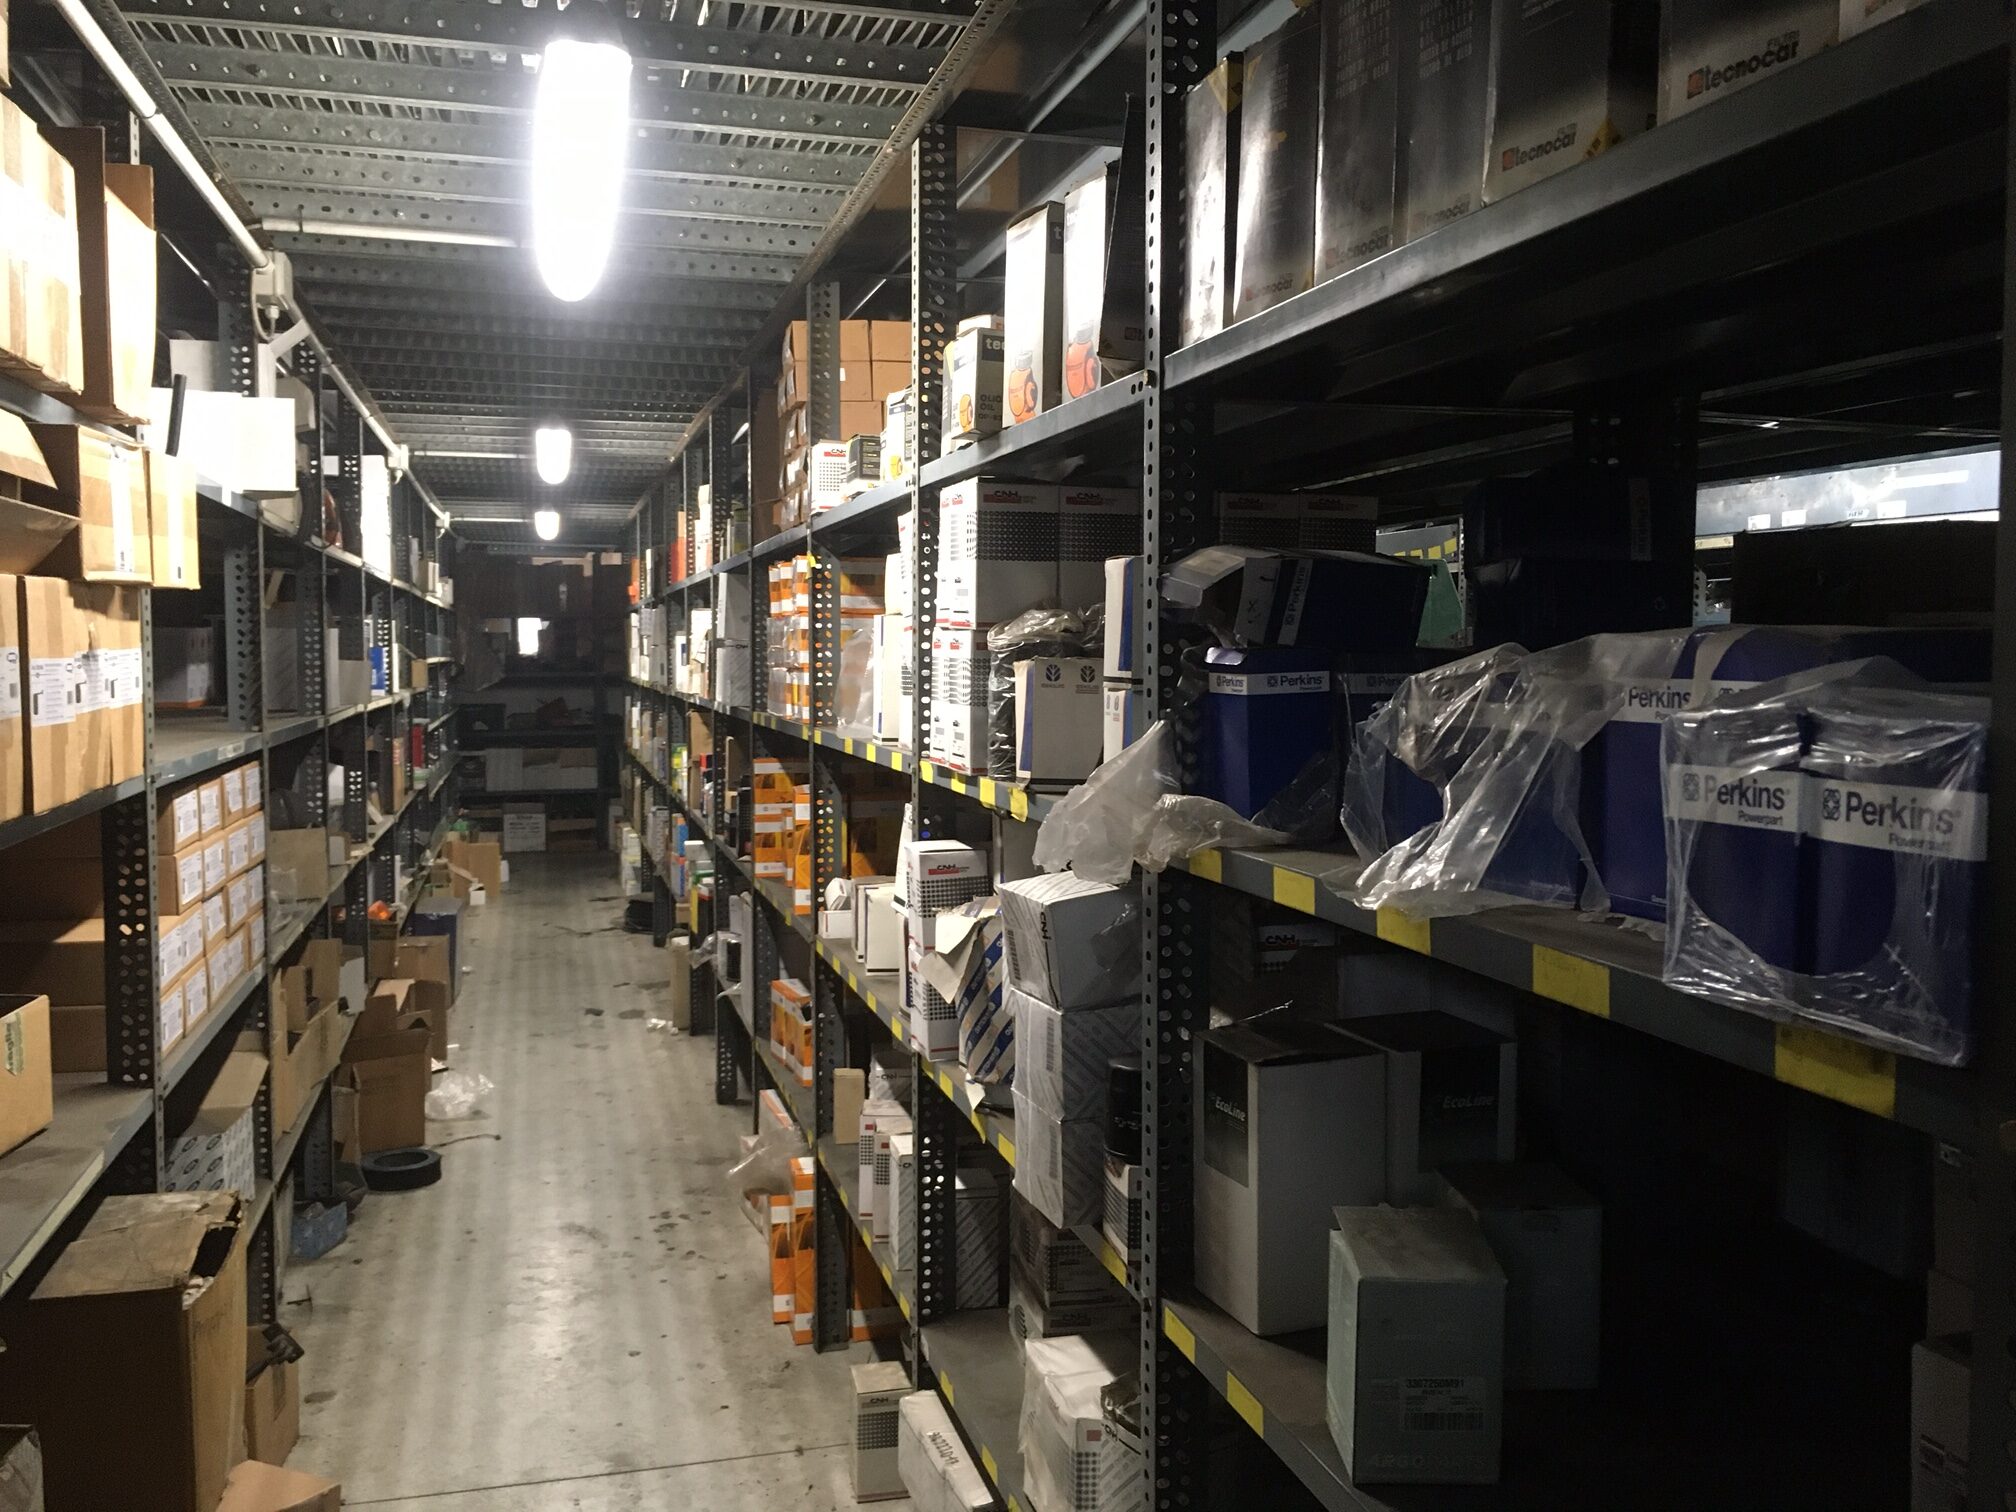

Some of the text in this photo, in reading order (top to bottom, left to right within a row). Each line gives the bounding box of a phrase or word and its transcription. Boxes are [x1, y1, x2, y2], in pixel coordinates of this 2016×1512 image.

[1704, 41, 1799, 91] tecnocar
[1515, 131, 1577, 167] tecnocar
[993, 490, 1019, 498] CNH
[1222, 676, 1244, 688] Perkins
[1280, 673, 1323, 686] Perkins
[1628, 685, 1691, 709] Perkins
[1705, 773, 1785, 811] Perkins
[1737, 810, 1783, 826] Powerpart
[1845, 791, 1954, 835] Perkins
[937, 863, 956, 871] CNH
[1040, 911, 1053, 940] CNH
[1265, 934, 1296, 945] CNH
[1215, 1096, 1246, 1122] EcoLine
[1442, 1095, 1495, 1109] EcoLine
